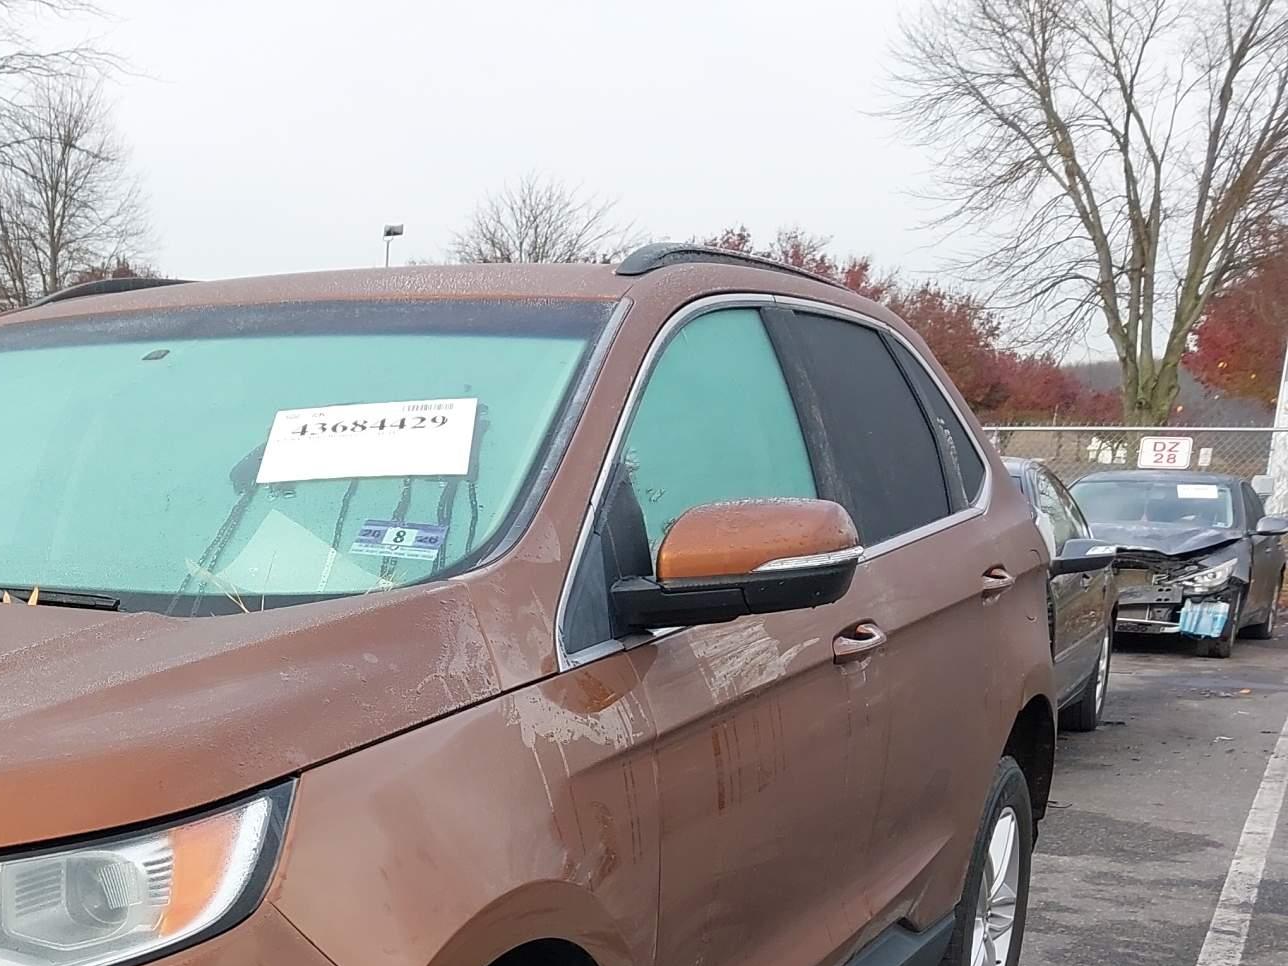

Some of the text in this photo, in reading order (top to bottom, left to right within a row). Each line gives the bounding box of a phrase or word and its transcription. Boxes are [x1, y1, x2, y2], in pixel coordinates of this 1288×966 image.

[291, 415, 449, 436] 43684429
[1153, 441, 1181, 453] DZ
[1153, 453, 1177, 464] 28
[392, 530, 406, 543] 8
